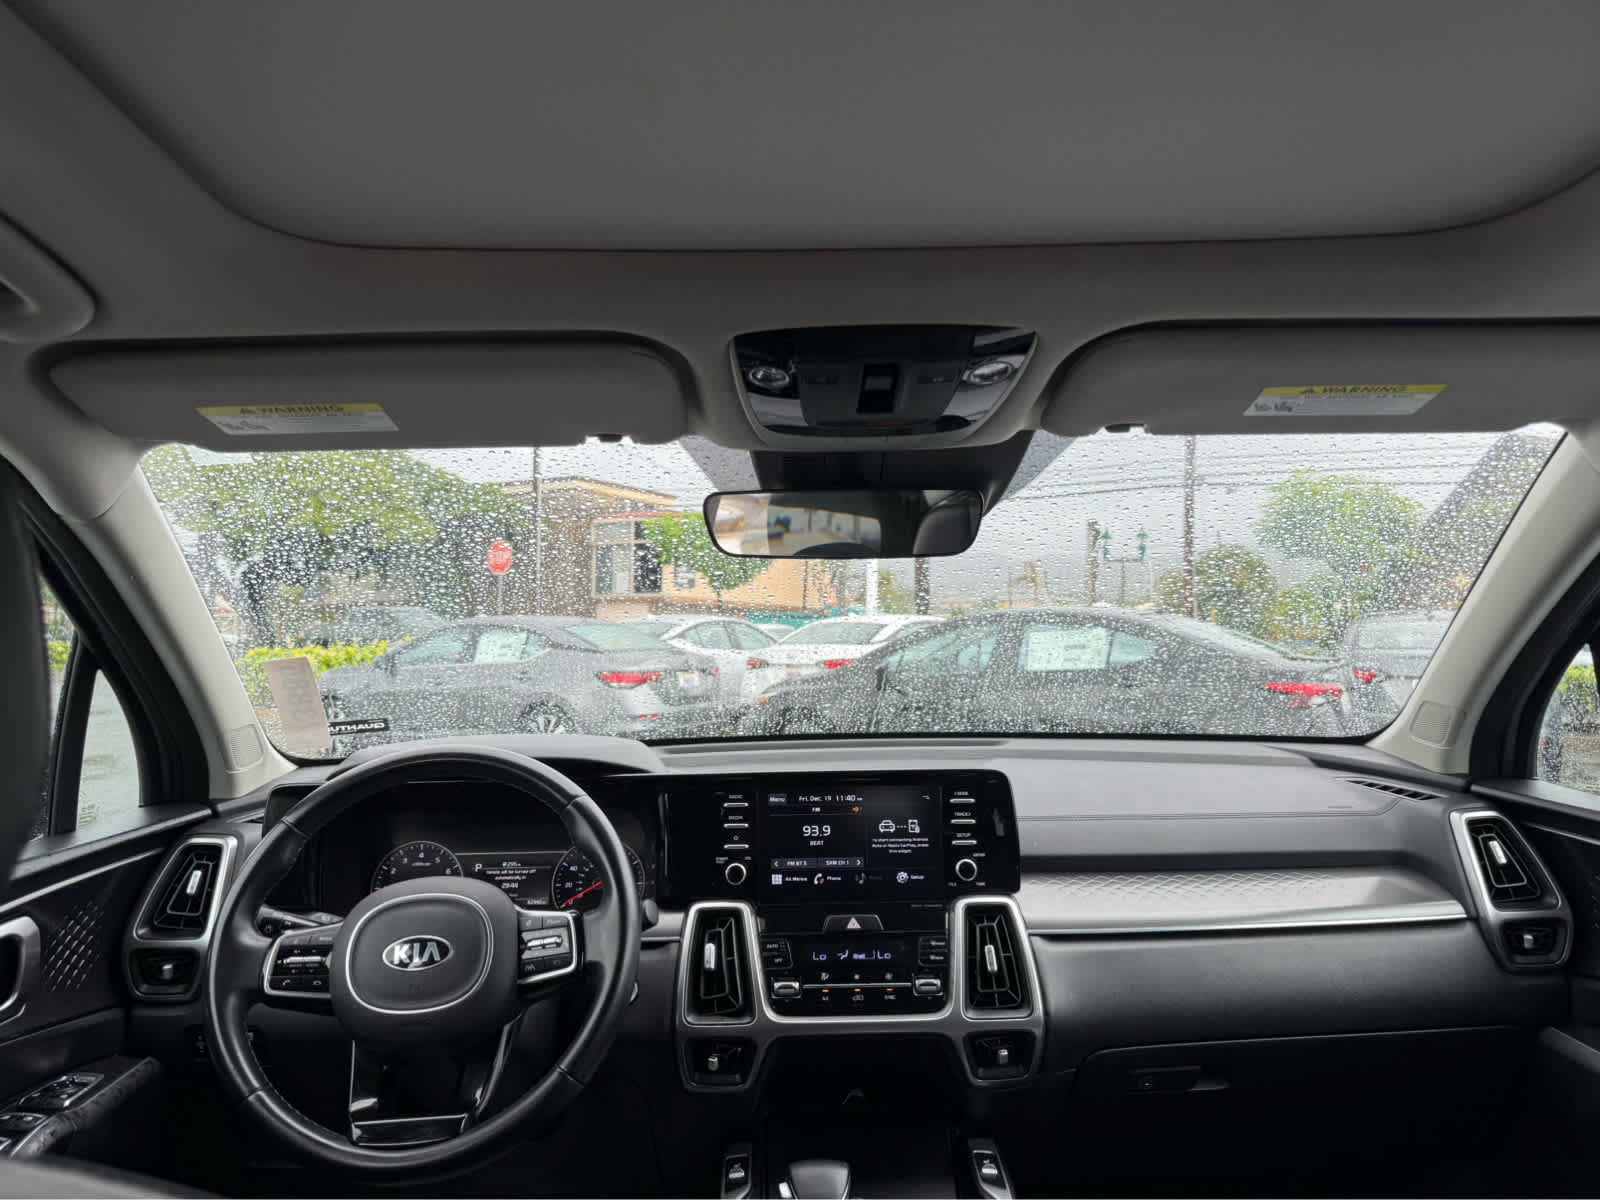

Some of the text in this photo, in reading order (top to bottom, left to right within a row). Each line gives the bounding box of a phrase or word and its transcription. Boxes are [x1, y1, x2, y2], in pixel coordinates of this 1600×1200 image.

[1322, 384, 1408, 394] WARNING
[258, 403, 345, 415] WARNING
[488, 551, 512, 563] STOP
[802, 825, 831, 837] 93.9
[474, 863, 483, 872] P
[393, 941, 441, 965] KIA
[812, 951, 827, 961] Lo
[877, 951, 892, 960] Lo
